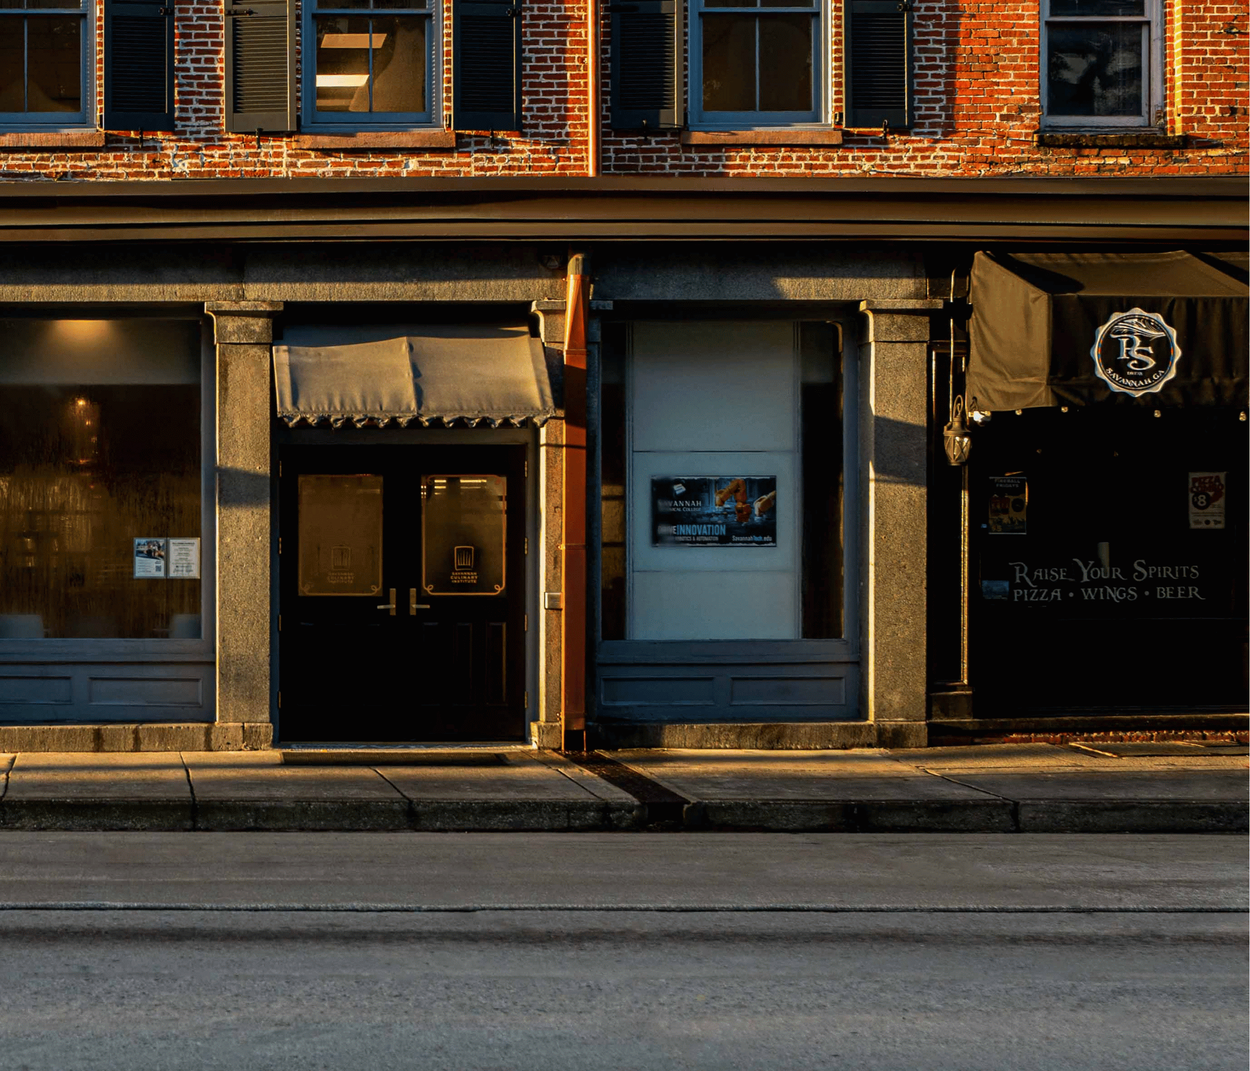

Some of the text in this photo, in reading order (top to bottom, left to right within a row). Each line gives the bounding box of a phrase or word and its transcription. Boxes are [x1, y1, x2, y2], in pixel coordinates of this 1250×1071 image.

[1191, 476, 1221, 486] PIZZA
[1008, 557, 1200, 588] RAISE YOUR SPIRITS
[1013, 588, 1062, 602] PIZZA
[1080, 585, 1139, 603] WINGS
[1156, 586, 1207, 601] BEER
